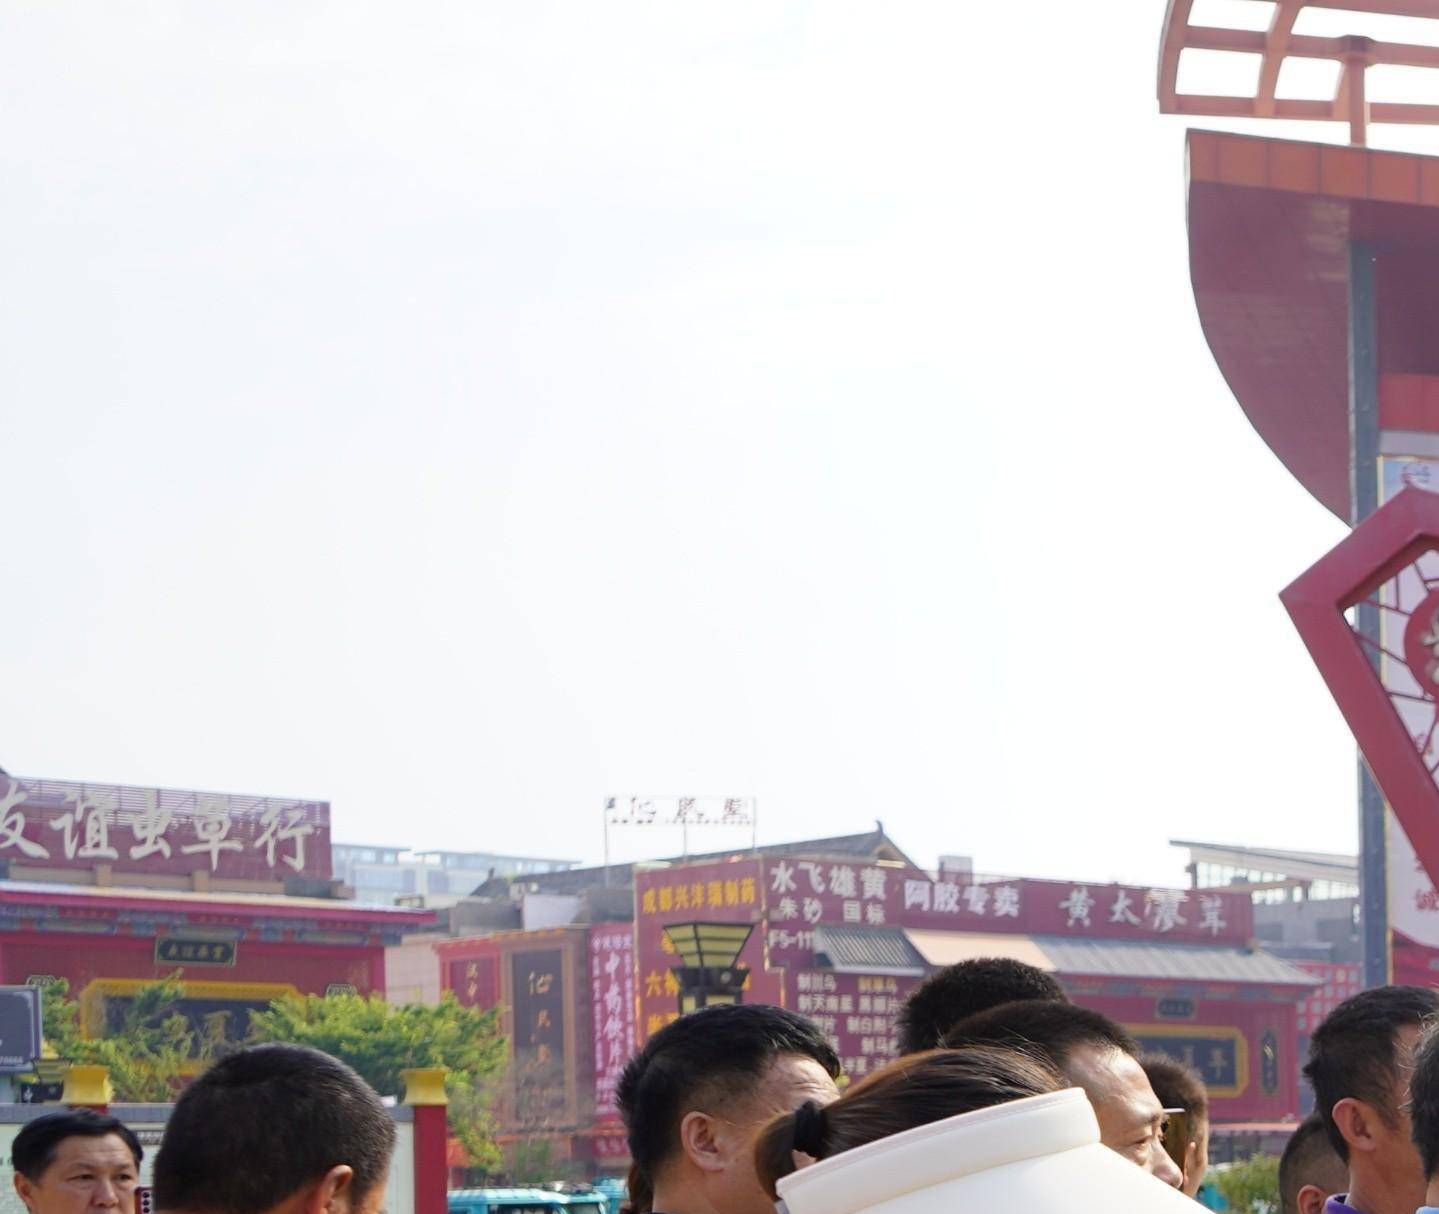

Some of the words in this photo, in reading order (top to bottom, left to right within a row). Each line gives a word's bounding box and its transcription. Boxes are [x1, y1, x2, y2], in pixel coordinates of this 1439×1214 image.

[770, 862, 888, 900] 水飞雄黄
[904, 879, 1020, 918] 阿胶专卖
[778, 897, 823, 924] 朱砂
